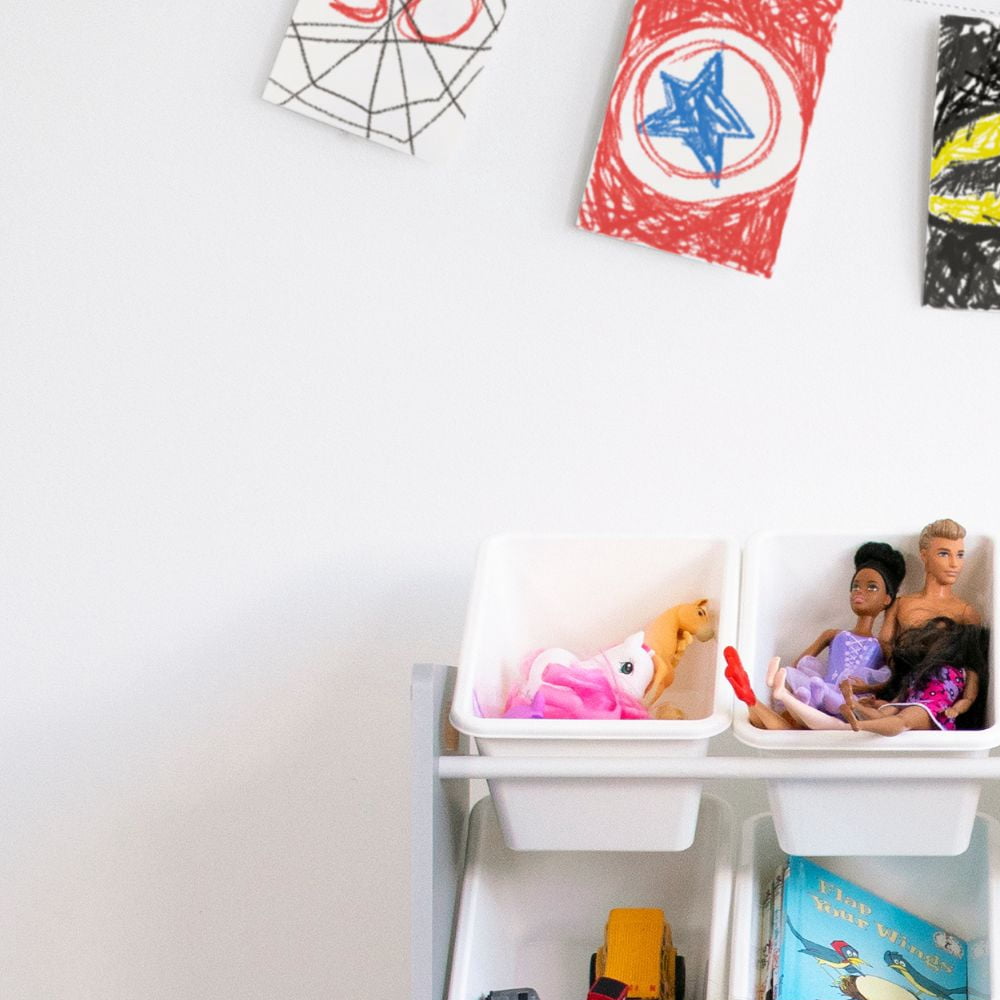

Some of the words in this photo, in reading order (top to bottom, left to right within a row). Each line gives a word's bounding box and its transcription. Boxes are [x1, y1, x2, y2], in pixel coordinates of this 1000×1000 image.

[819, 880, 872, 915] Flap
[811, 894, 870, 929] Your
[876, 922, 954, 973] Wings
